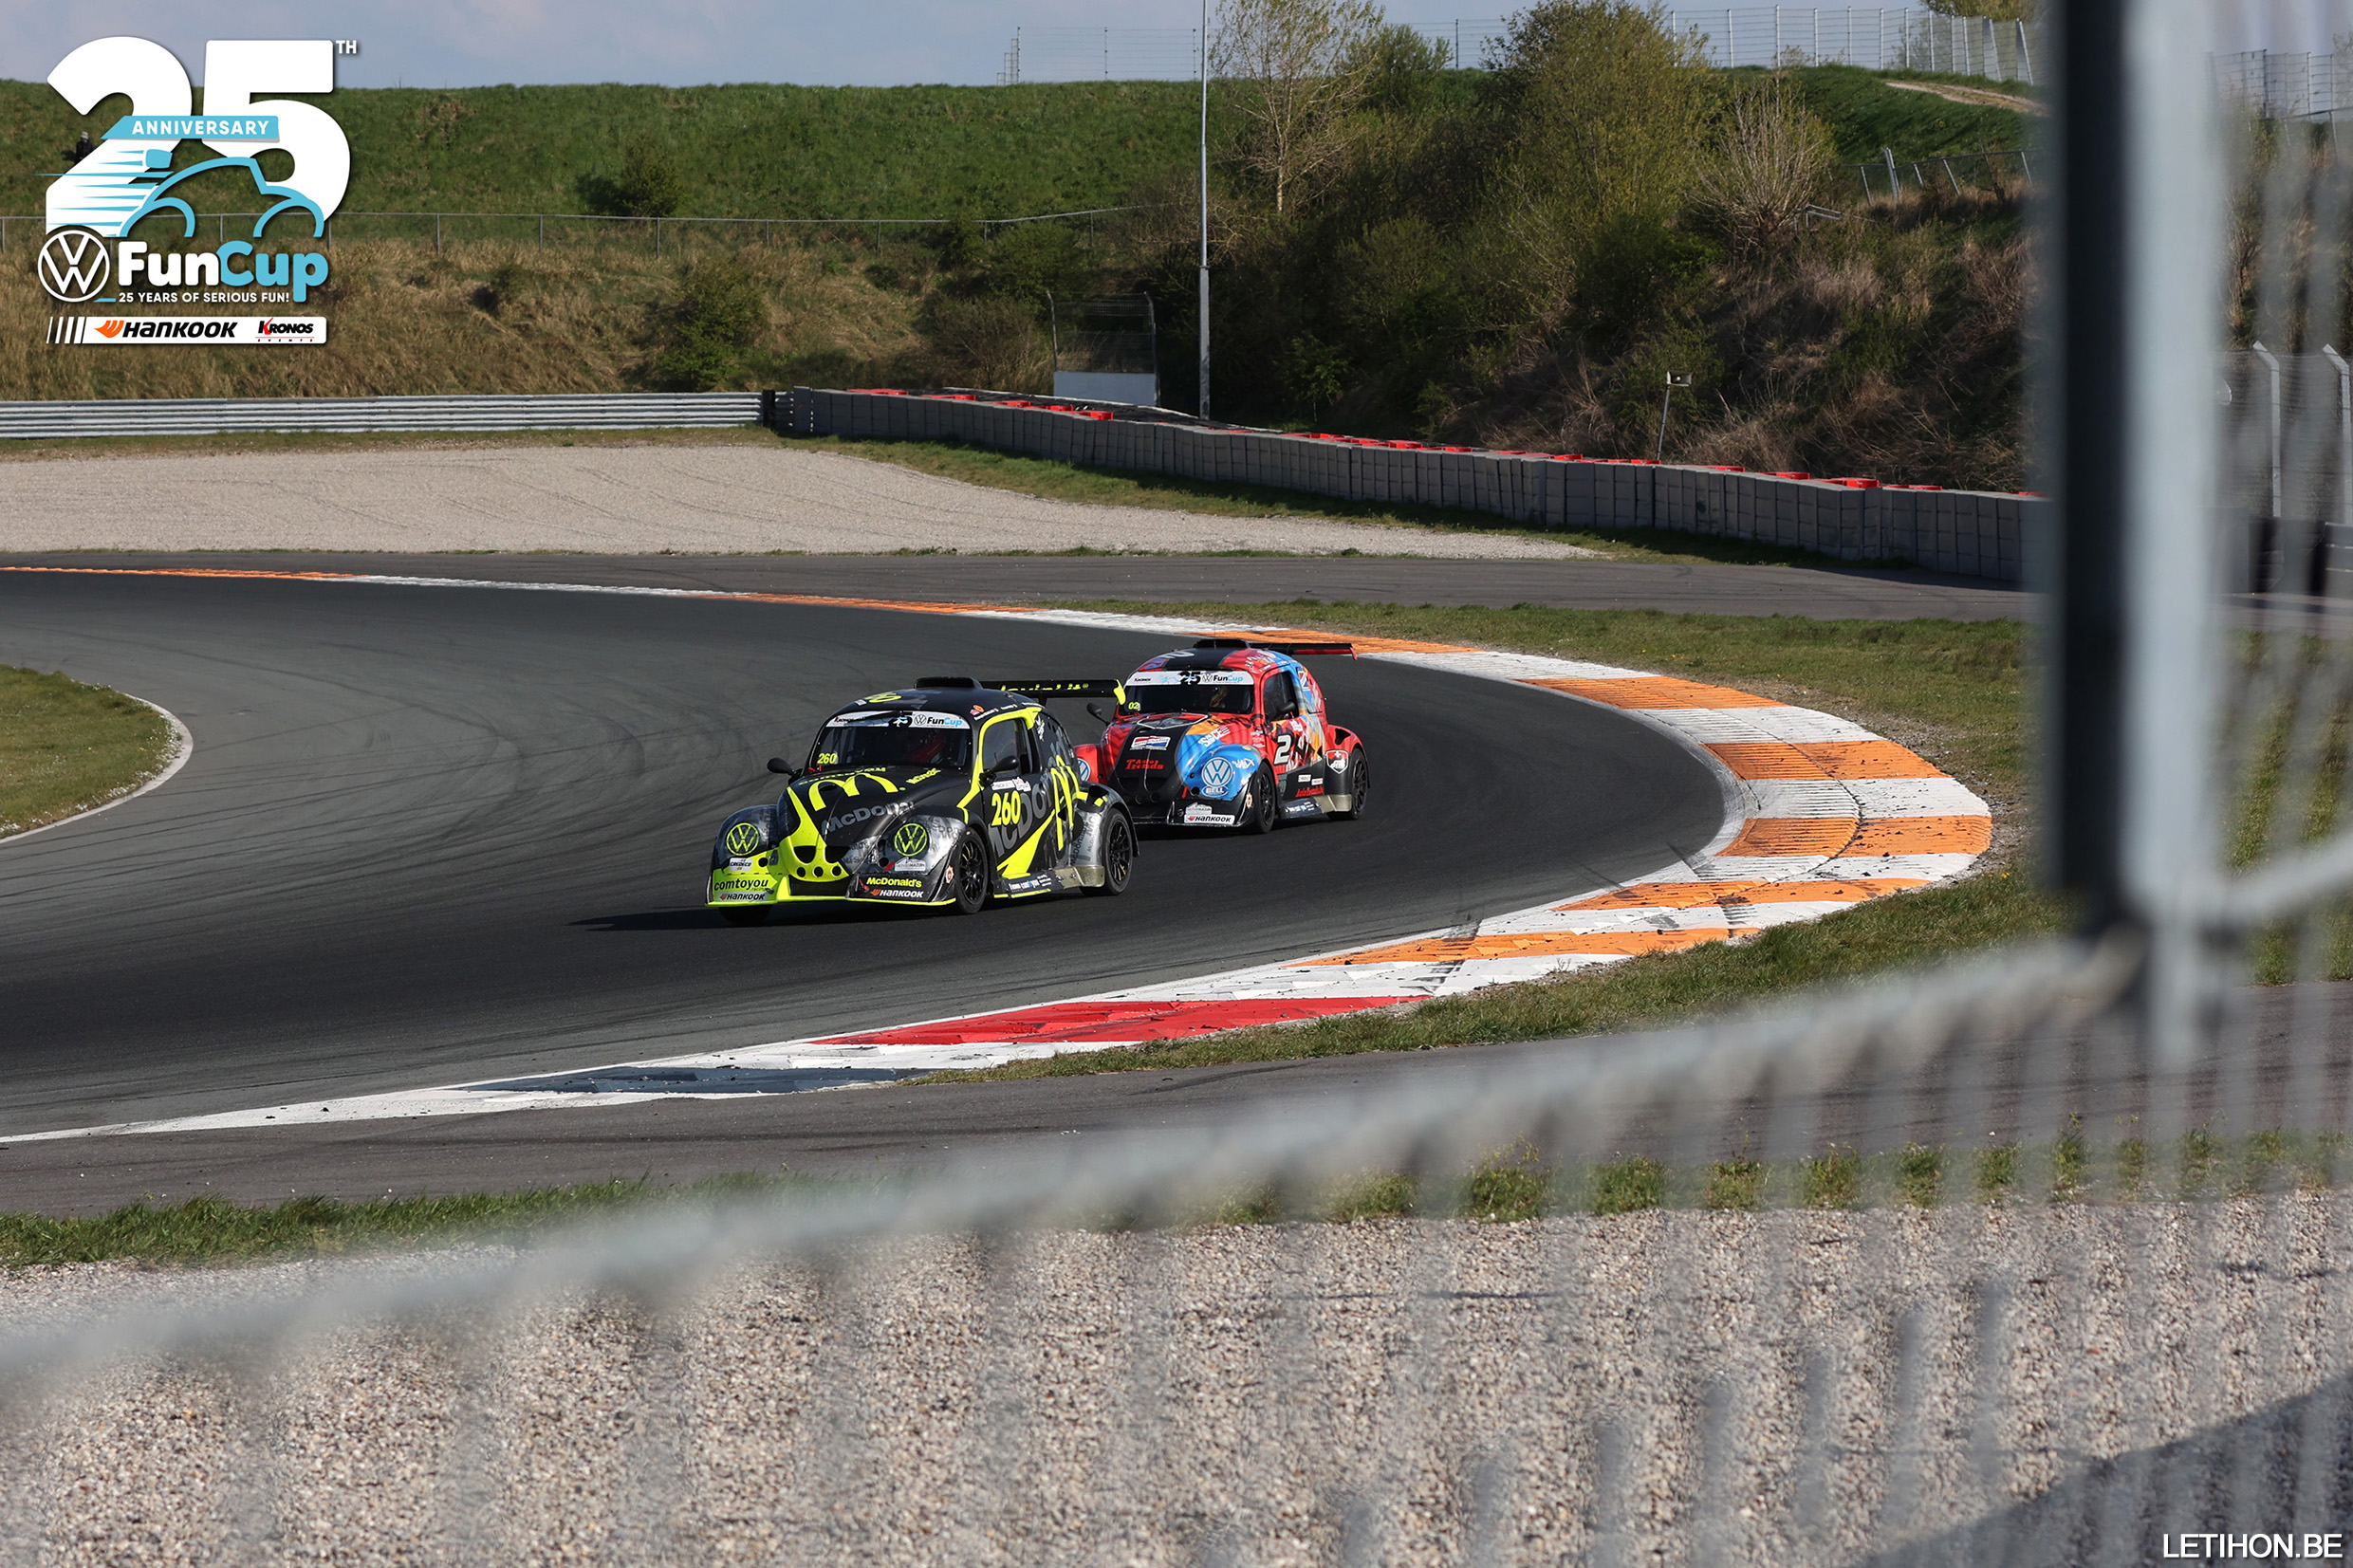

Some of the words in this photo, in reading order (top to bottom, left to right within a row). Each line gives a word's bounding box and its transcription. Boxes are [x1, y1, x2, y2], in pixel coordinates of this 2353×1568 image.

[927, 716, 963, 727] FunCup
[817, 753, 837, 765] 260
[991, 790, 1022, 826] 260
[713, 878, 769, 891] comtoyou
[866, 877, 922, 888] McDonald's
